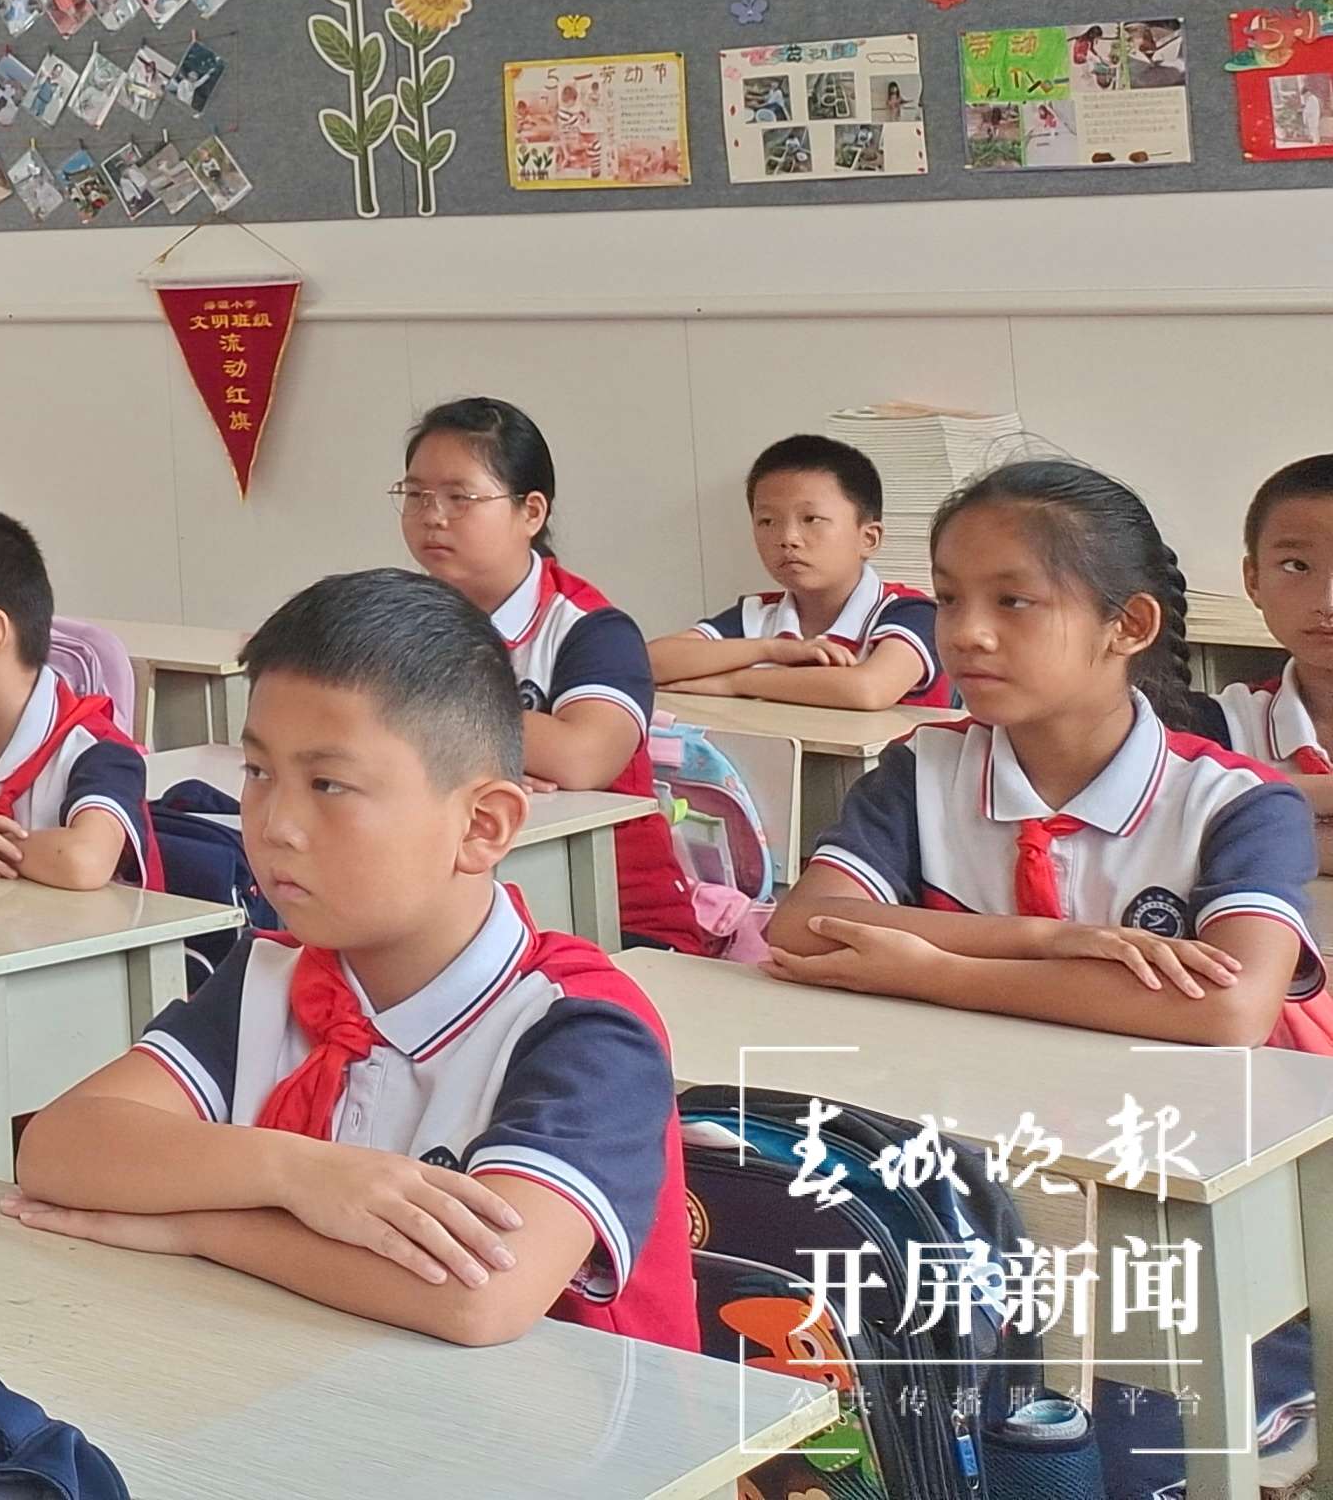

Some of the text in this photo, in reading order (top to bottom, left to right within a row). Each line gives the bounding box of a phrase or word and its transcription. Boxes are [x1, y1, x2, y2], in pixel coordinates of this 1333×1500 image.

[190, 313, 273, 331] 文明班级
[219, 333, 253, 431] 流动红旗
